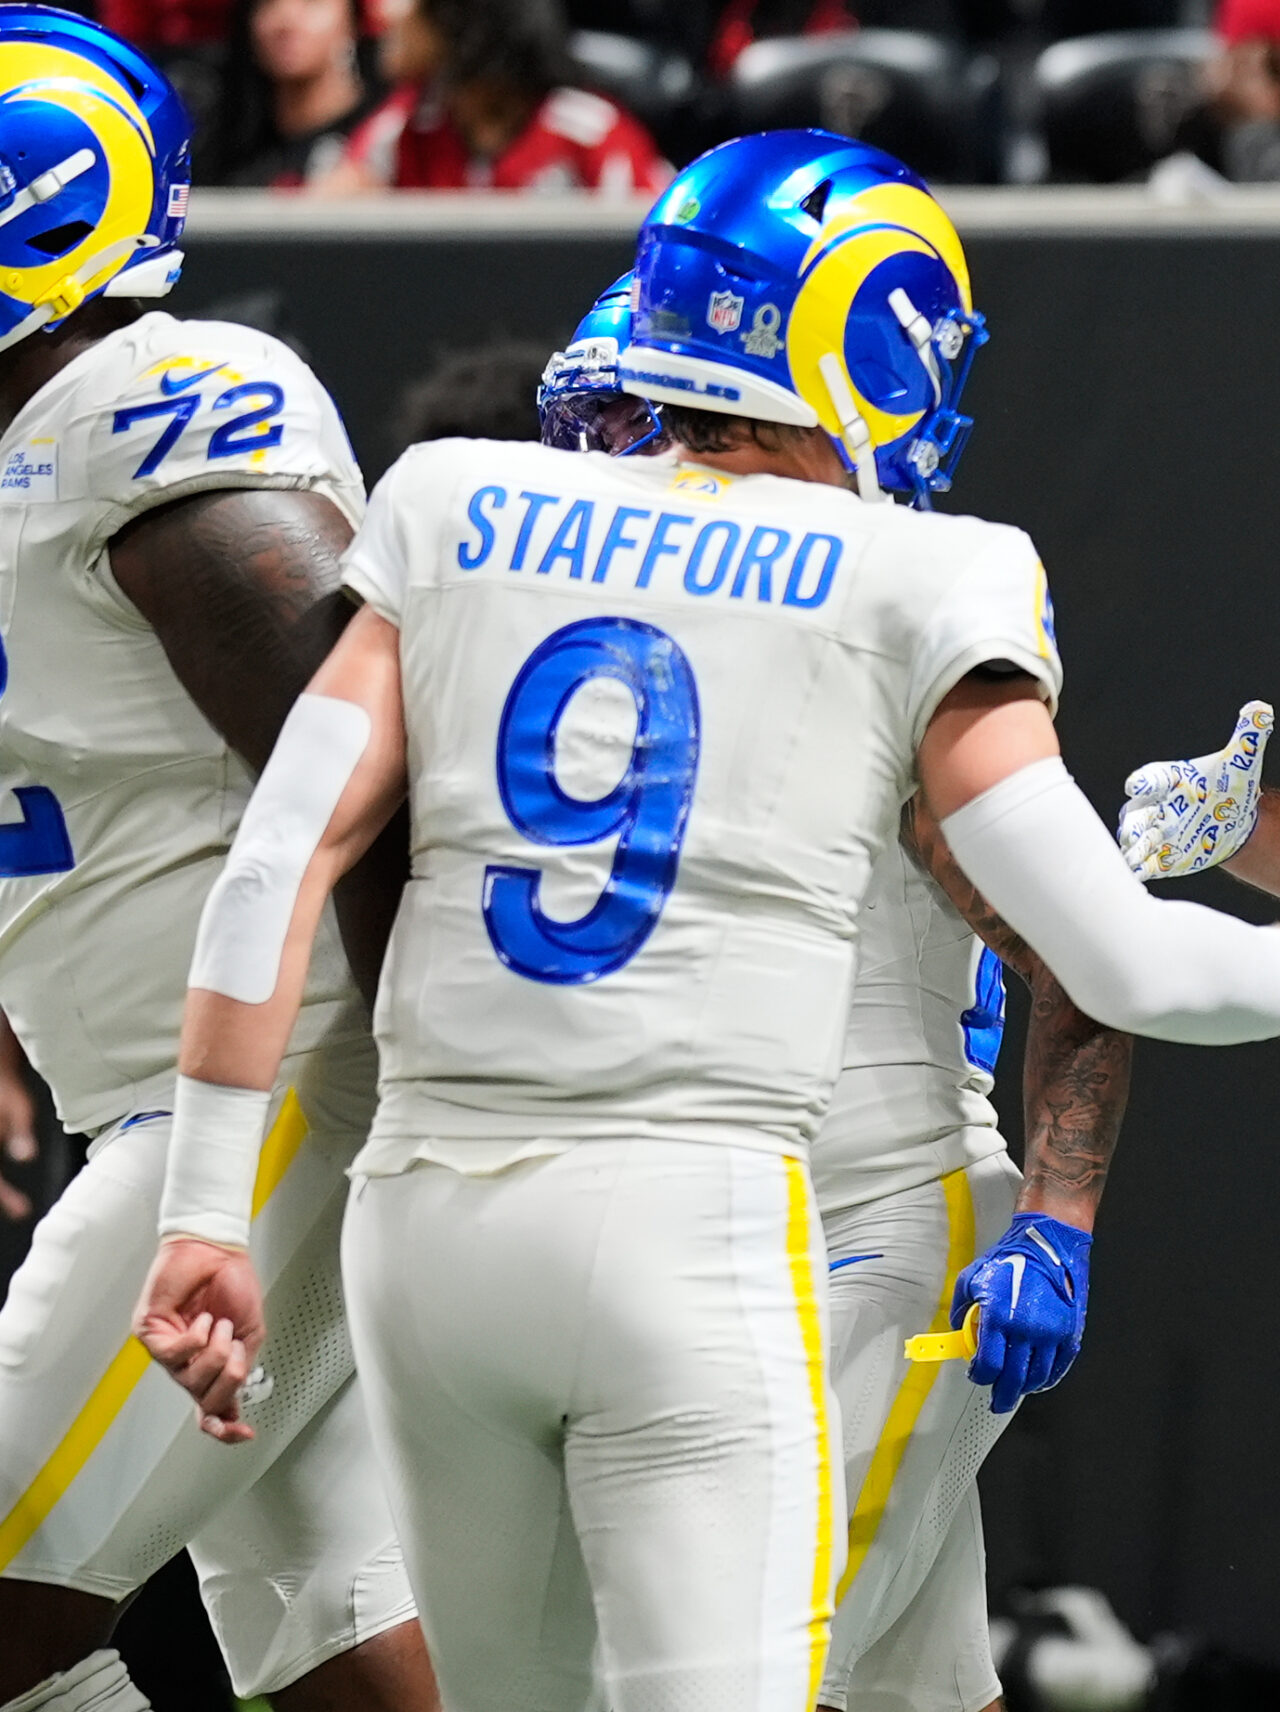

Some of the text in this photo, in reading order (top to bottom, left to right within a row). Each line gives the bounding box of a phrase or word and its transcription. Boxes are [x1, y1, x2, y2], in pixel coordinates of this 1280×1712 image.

[112, 381, 285, 480] 72
[458, 486, 843, 610] STAFFORD
[482, 616, 701, 986] 9
[1168, 795, 1189, 817] 12
